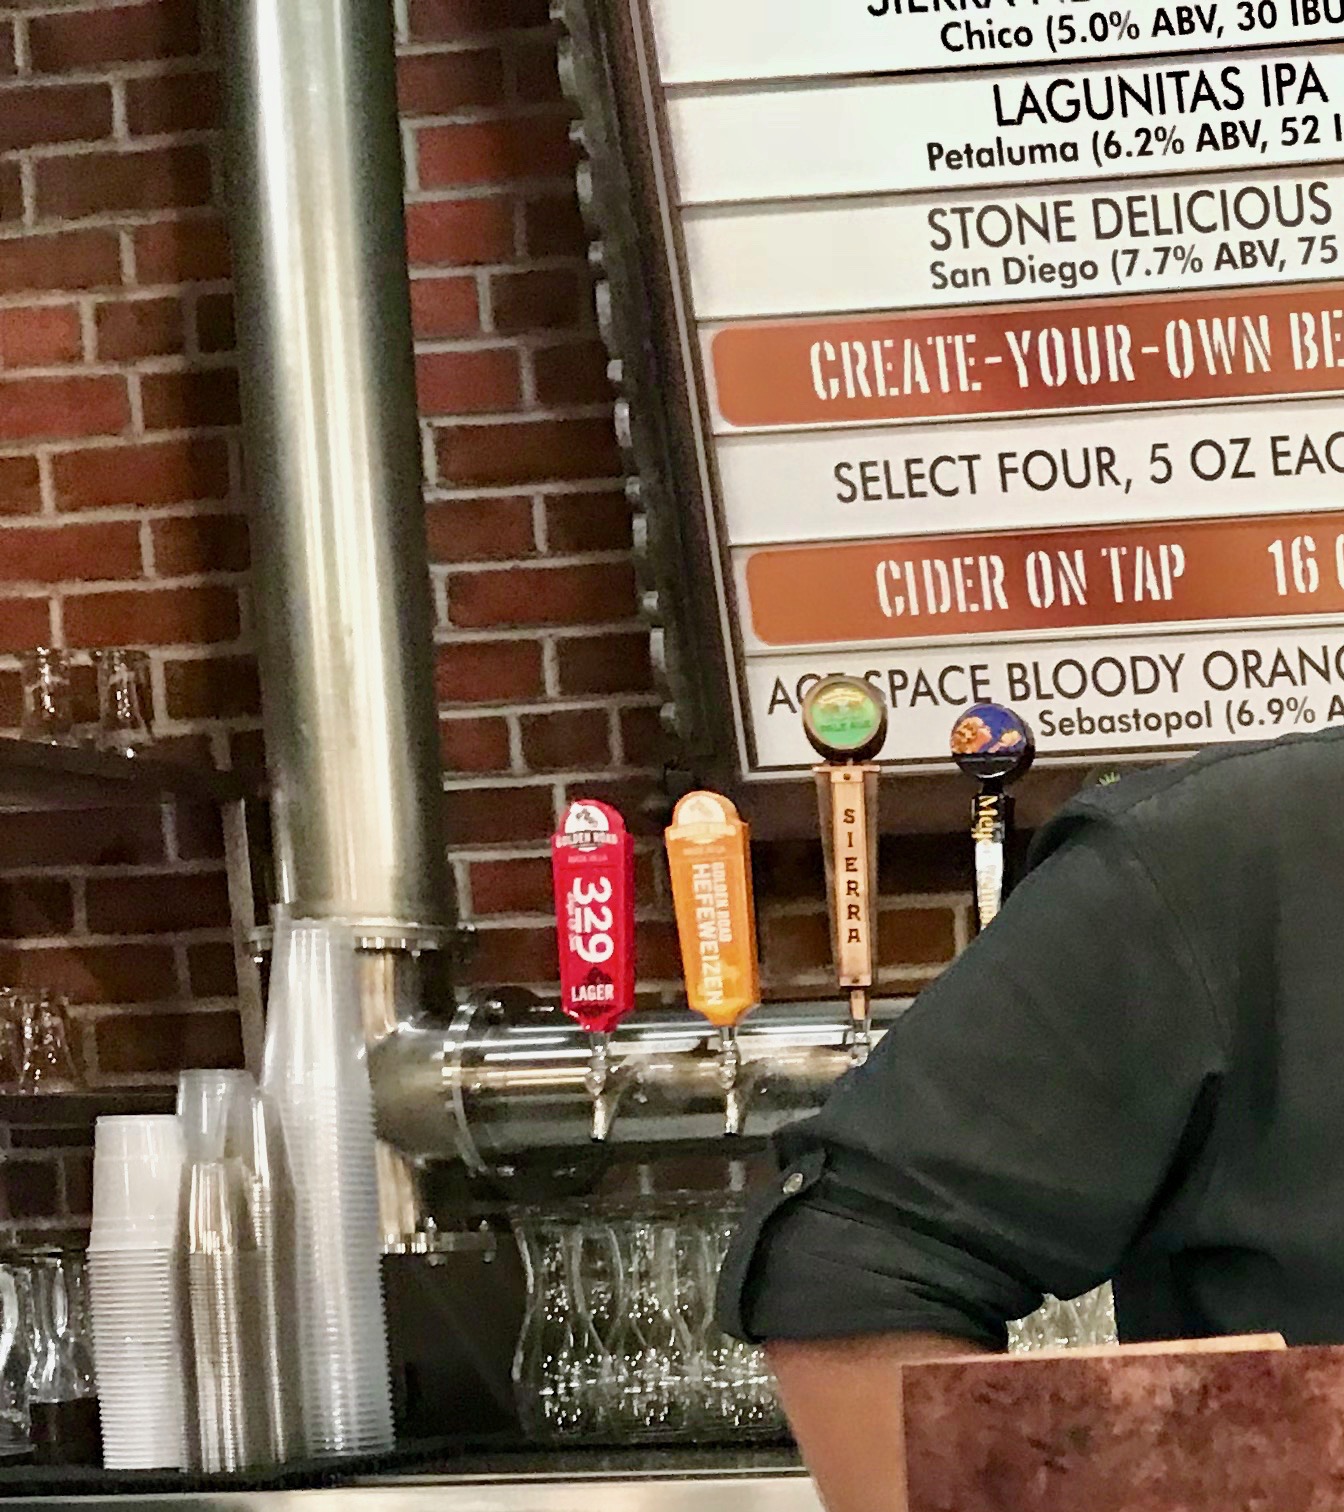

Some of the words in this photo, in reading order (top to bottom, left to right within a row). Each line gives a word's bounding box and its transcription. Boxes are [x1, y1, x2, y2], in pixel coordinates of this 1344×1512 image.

[940, 18, 1033, 52] Chico
[1046, 10, 1140, 53] (5.0%
[1151, 4, 1224, 39] ABV,
[1237, 1, 1277, 31] 30
[992, 66, 1244, 127] LAGUNITAS
[1261, 60, 1329, 107] IPA
[927, 135, 1079, 172] Petaluma
[1092, 124, 1184, 168] (6.2%
[1195, 117, 1268, 155] ABV,
[1281, 115, 1321, 146] 52
[928, 200, 1078, 251] STONE
[1094, 181, 1333, 243] DELICIOUS
[930, 259, 991, 290] San
[1004, 254, 1098, 288] Diego
[1110, 243, 1203, 285] (7.7%
[1214, 237, 1287, 273] ABV,
[1299, 233, 1339, 265] 75
[809, 314, 1274, 401] CREATE-YOUR-OWN
[833, 454, 981, 504] SELECT
[997, 446, 1133, 494] FOUR,
[1149, 442, 1174, 484] 5
[1190, 437, 1256, 482] OZ
[876, 554, 1009, 618] CIDER
[1025, 549, 1088, 609] ON
[1101, 543, 1186, 603] TAP
[1267, 535, 1320, 597] 16
[1006, 652, 1186, 702] BLOODY
[1039, 700, 1212, 738] Sebastopol
[1225, 695, 1316, 735] (6.9%
[842, 808, 862, 944] SIERRA
[572, 876, 615, 964] 329
[691, 863, 725, 1006] HEFEWEIZEN
[571, 983, 615, 1003] LAGER
